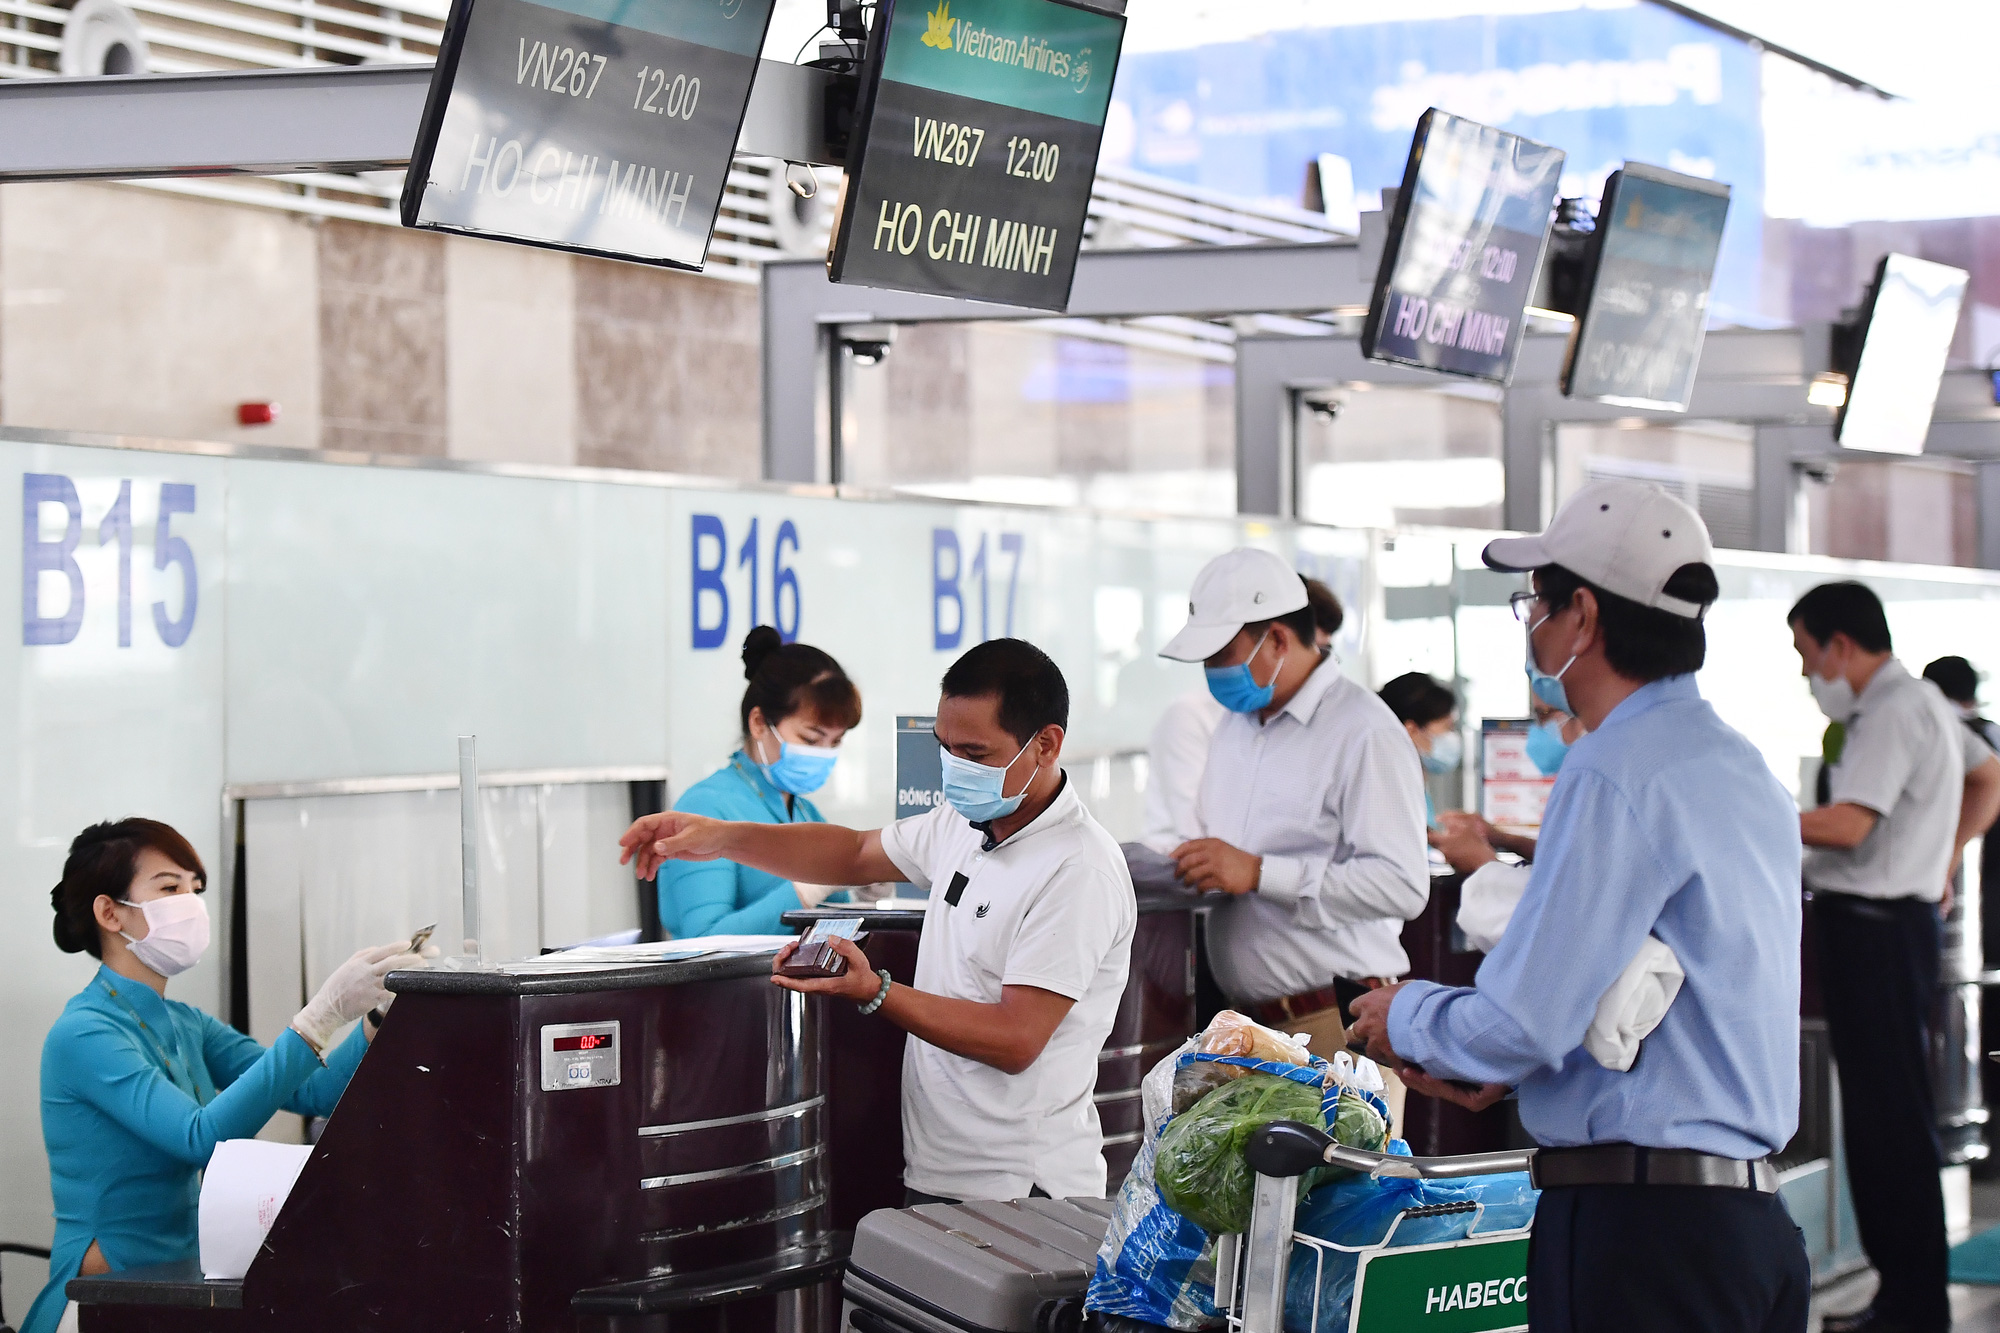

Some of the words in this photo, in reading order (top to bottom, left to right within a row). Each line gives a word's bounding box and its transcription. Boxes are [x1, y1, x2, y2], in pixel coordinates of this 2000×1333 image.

[516, 37, 608, 99] VN267
[633, 65, 701, 121] 12:00
[460, 133, 523, 198] HO
[529, 146, 599, 212] CHI
[599, 160, 694, 228] MINH
[913, 116, 985, 168] VN267
[1005, 135, 1060, 183] 12:00
[873, 200, 923, 256] HO
[927, 208, 982, 265] CHI
[981, 217, 1058, 276] MINH
[1393, 295, 1428, 341] HO
[1426, 302, 1464, 348] CHI
[1457, 307, 1510, 357] MINH
[22, 472, 198, 649] B15
[691, 514, 801, 650] B16
[932, 528, 1025, 652] B17
